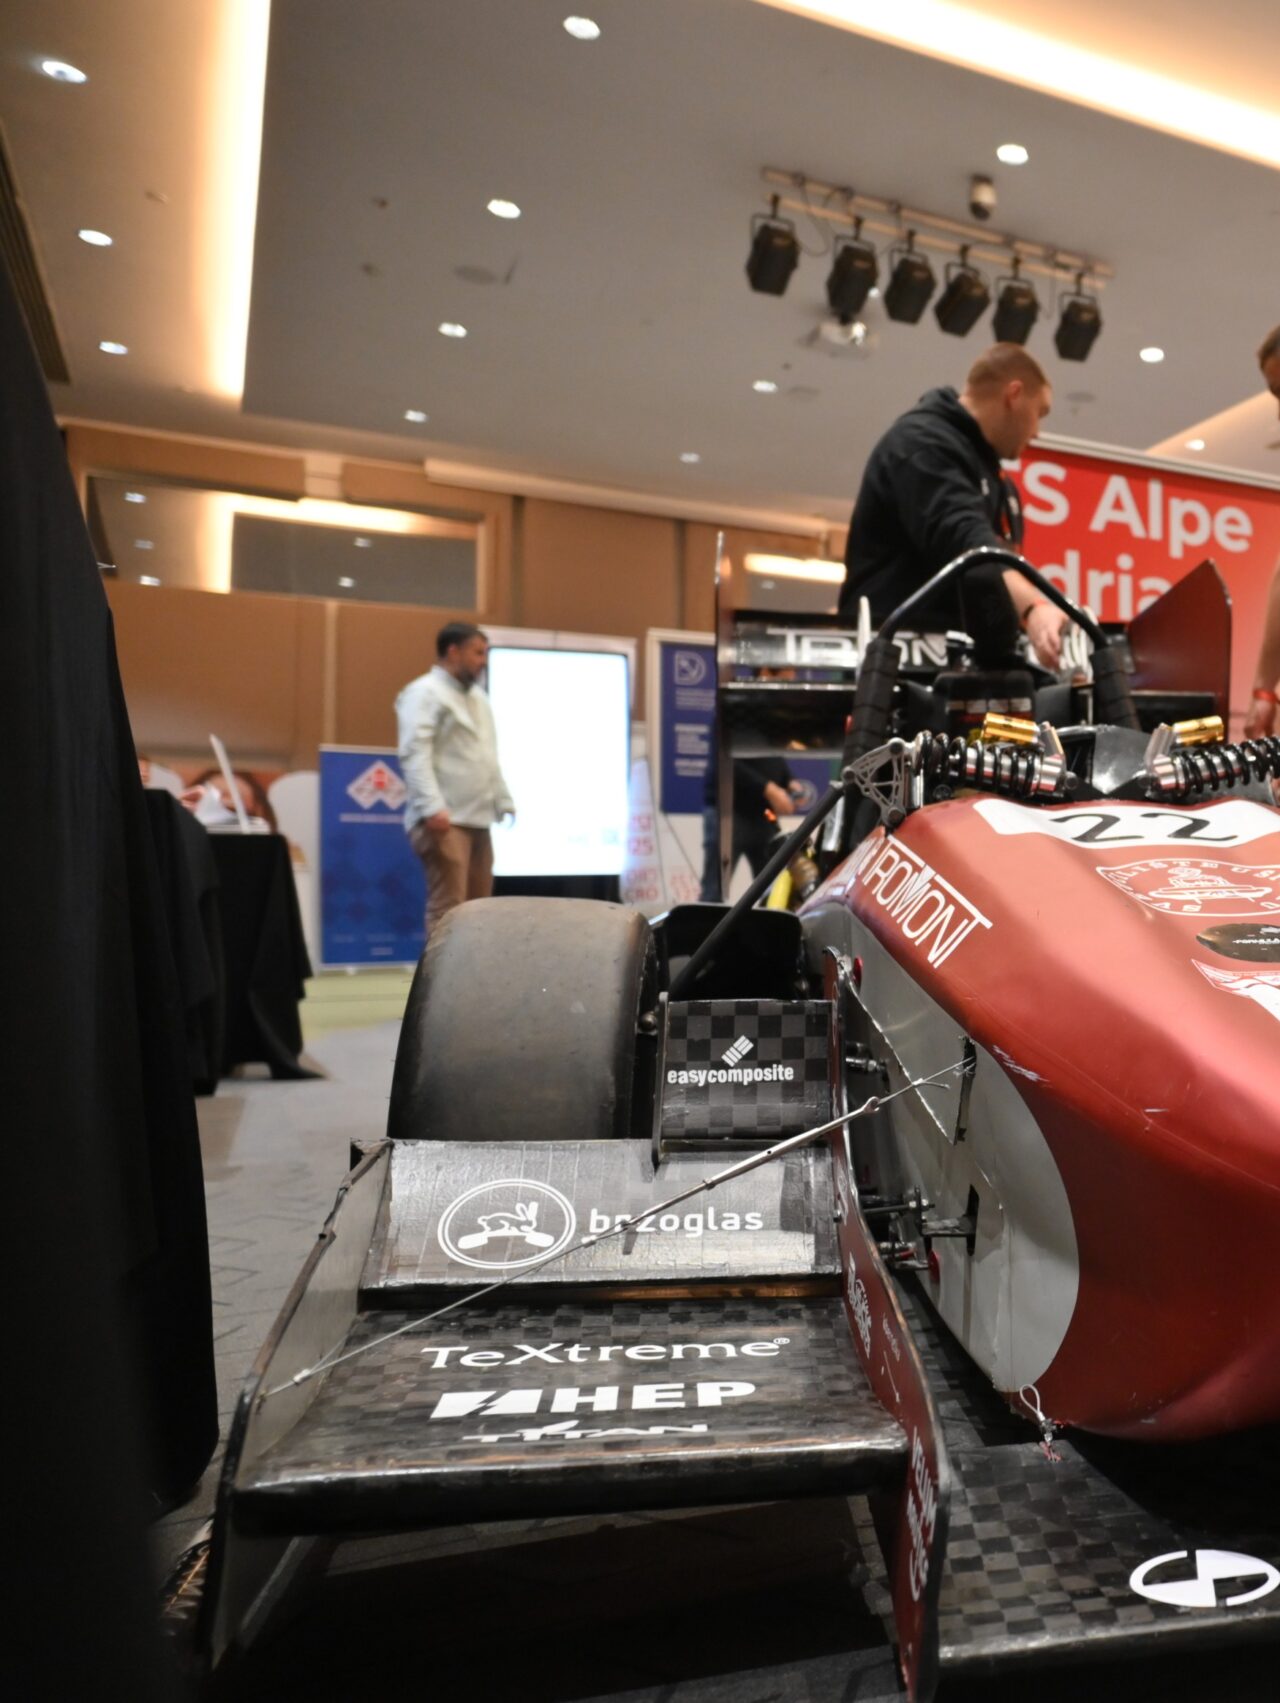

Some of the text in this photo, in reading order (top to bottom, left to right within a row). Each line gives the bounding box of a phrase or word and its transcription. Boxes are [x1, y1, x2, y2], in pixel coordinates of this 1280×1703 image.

[1089, 474, 1253, 559] Alpe
[1049, 812, 1239, 843] 22
[667, 1064, 794, 1086] easycomposite
[589, 1207, 763, 1236] brzoglas
[550, 1381, 755, 1413] HEP
